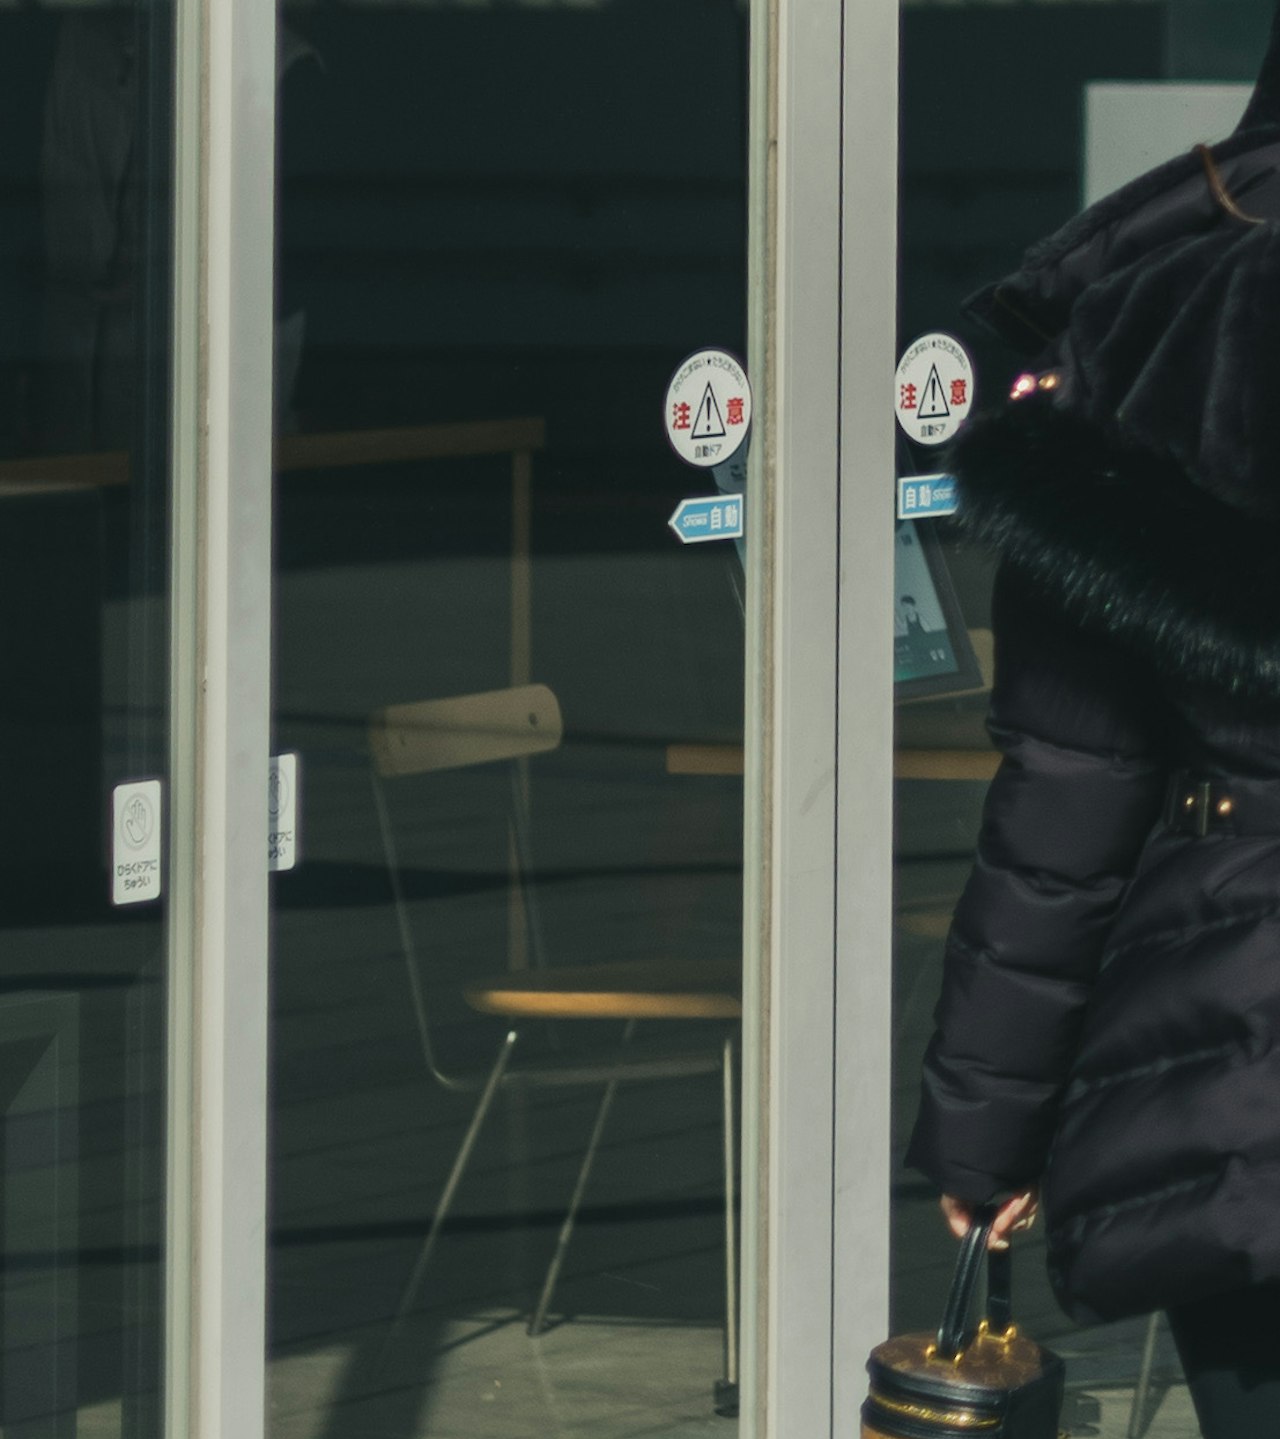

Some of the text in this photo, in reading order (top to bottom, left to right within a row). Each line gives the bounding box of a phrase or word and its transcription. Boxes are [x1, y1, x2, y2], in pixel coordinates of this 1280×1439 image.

[920, 423, 947, 437] 自動ドア
[694, 444, 723, 459] 自動ドア
[905, 483, 931, 509] 自動
[710, 504, 738, 530] 自動
[116, 858, 158, 877] ひらくドアに
[123, 875, 152, 892] ちゅうい
